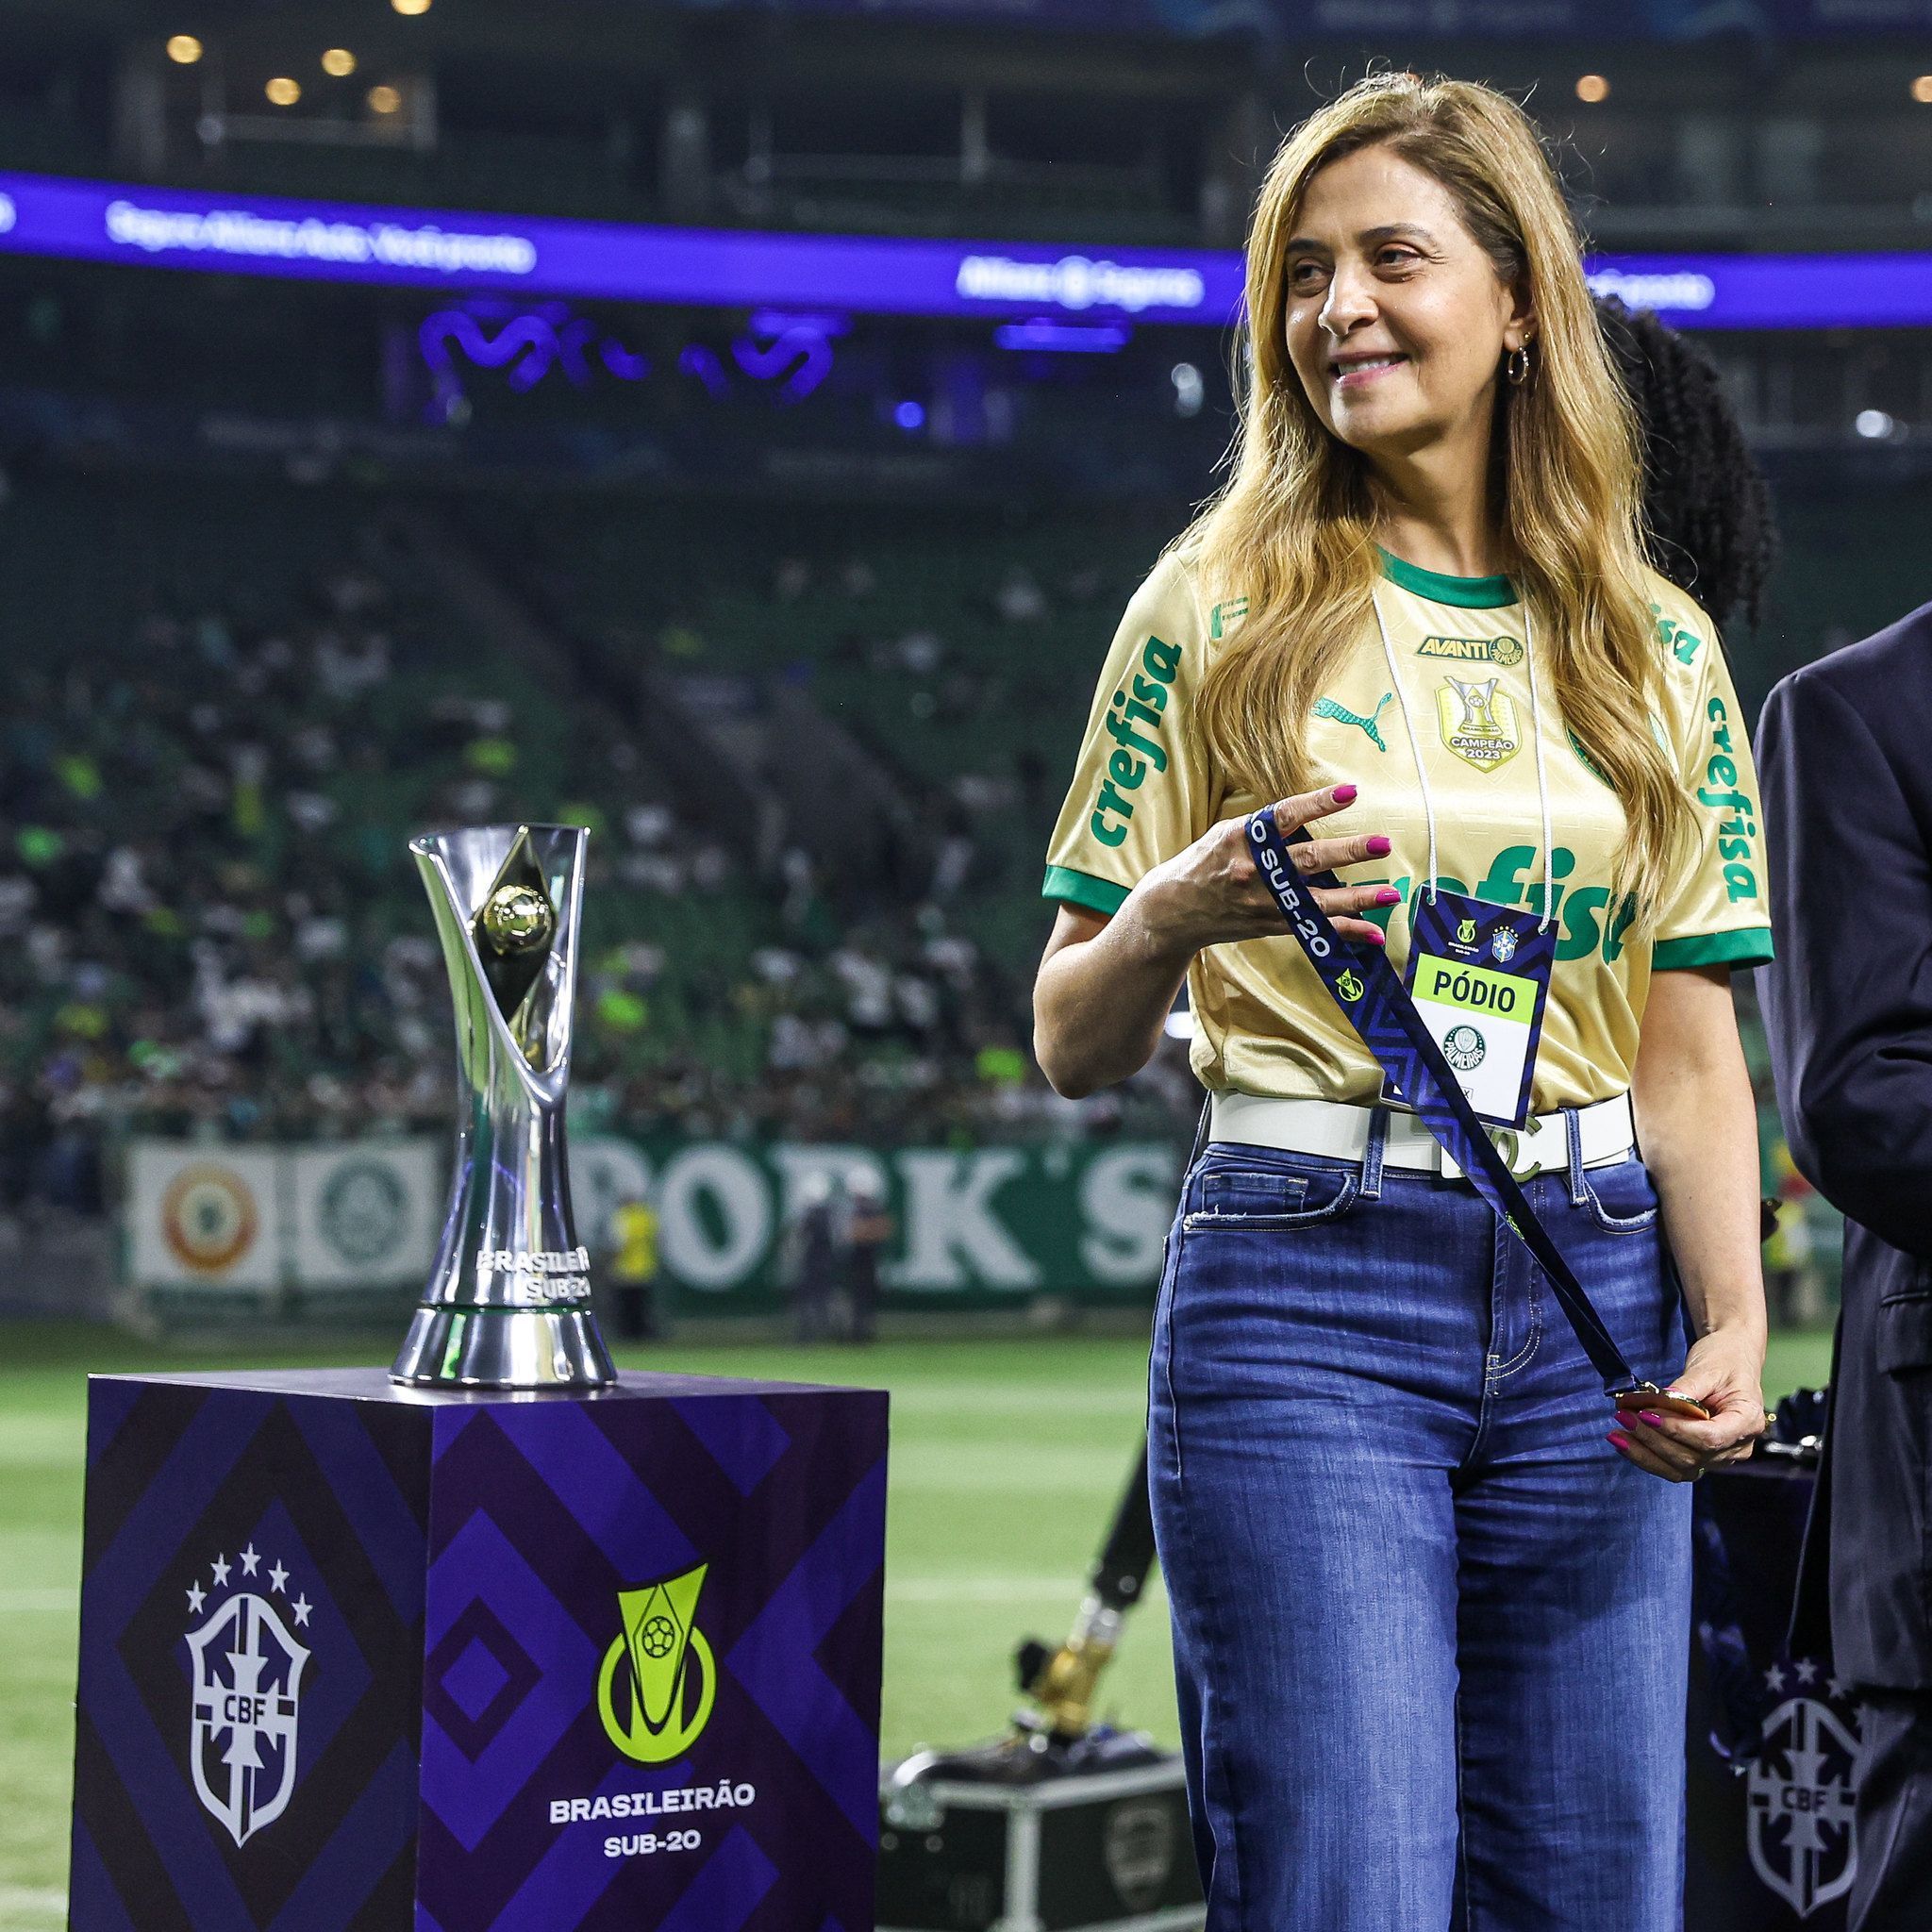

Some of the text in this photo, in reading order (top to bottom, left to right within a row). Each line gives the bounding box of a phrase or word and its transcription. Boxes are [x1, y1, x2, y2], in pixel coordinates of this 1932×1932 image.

[1421, 638, 1489, 659] AVANTI
[1091, 636, 1182, 847] crefisa
[1451, 737, 1513, 751] CAMPEÃO
[1466, 748, 1501, 759] 2023
[1698, 697, 1757, 904] crefisa
[1261, 848, 1331, 958] SUB-20
[1433, 970, 1516, 1013] PÓDIO
[1444, 1041, 1485, 1070] PALMEIRAS
[224, 1694, 266, 1726] CBF
[549, 1778, 757, 1824] BRASILEIRÃO
[603, 1829, 702, 1858] SUB-20
